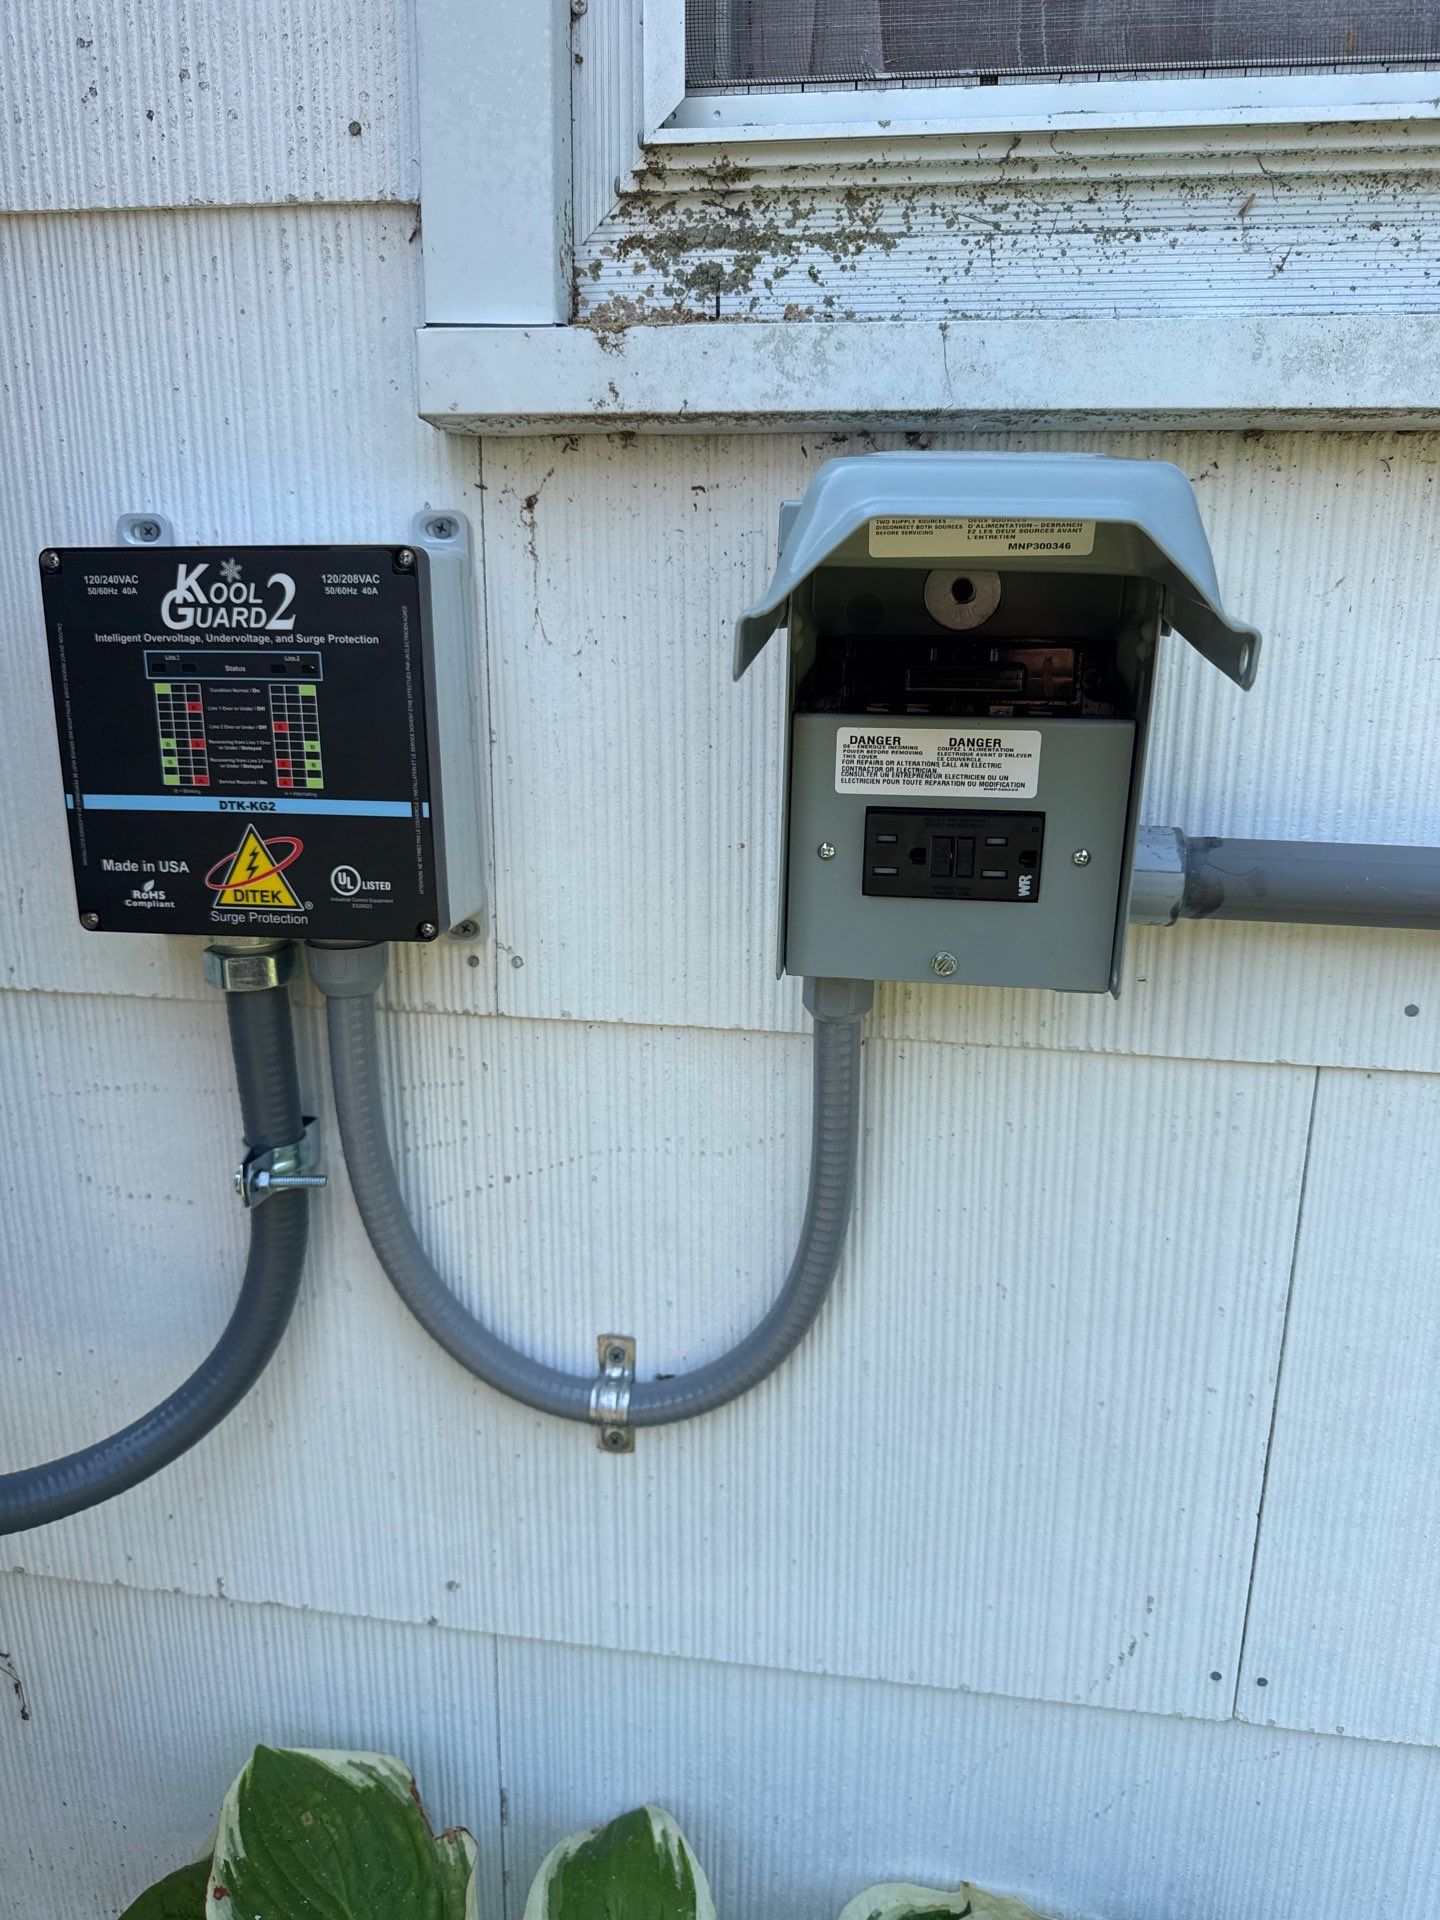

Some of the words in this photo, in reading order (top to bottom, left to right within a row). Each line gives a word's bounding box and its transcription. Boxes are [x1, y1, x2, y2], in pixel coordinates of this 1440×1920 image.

[84, 575, 139, 584] 120/240VAC
[174, 564, 263, 604] KOOL
[322, 574, 381, 584] 120/208VAC
[325, 587, 358, 595] 50/60Hz
[161, 589, 267, 630] GUARD
[264, 573, 296, 630] 2
[95, 633, 142, 644] Intelligent
[143, 633, 204, 644] Overvoltage,
[206, 634, 274, 645] Undervoltage,
[275, 634, 294, 643] and
[296, 635, 326, 645] Surge
[328, 634, 380, 644] Protection
[849, 736, 902, 745] DANGER
[949, 738, 1002, 747] DANGER
[219, 800, 277, 812] DTK-KG2
[102, 859, 139, 871] Made
[142, 860, 156, 872] in
[158, 861, 190, 873] USA
[362, 881, 392, 891] LISTED
[1018, 874, 1033, 897] WR
[132, 890, 167, 900] RoHS
[233, 890, 283, 904] DITEK
[125, 899, 175, 909] Compliant
[211, 911, 246, 925] Surge
[249, 912, 309, 925] Protection
